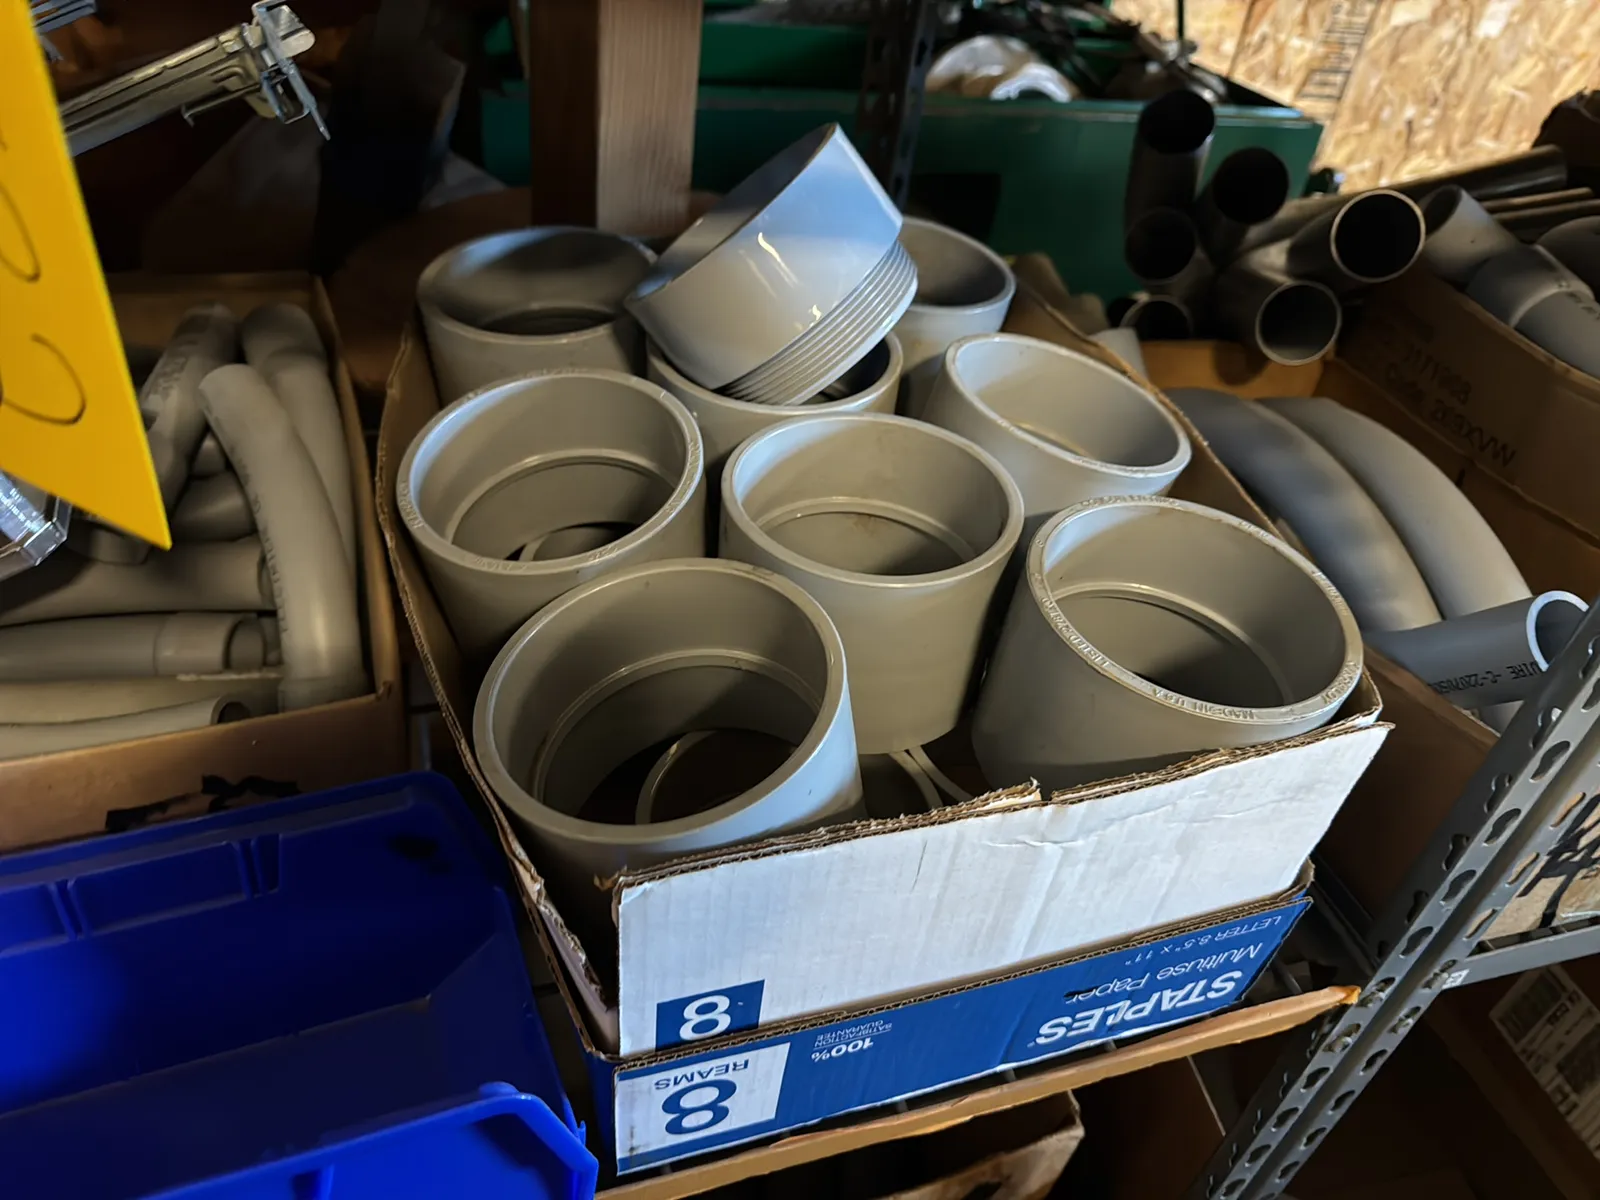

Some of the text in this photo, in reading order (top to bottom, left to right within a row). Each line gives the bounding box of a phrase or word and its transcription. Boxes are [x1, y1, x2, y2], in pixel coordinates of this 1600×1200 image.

[1214, 915, 1282, 942] LETTER
[1174, 934, 1212, 952] 8.5"
[1125, 950, 1154, 966] 11"
[1065, 942, 1264, 1005] Multiuse Paper
[679, 995, 731, 1041] 8
[1034, 970, 1244, 1046] STAPLES
[814, 1023, 893, 1048] SATISFACTION
[816, 1020, 884, 1042] GUARANTEE
[811, 1037, 874, 1063] 100%
[654, 1058, 750, 1091] REAMS
[661, 1079, 737, 1135] 8
